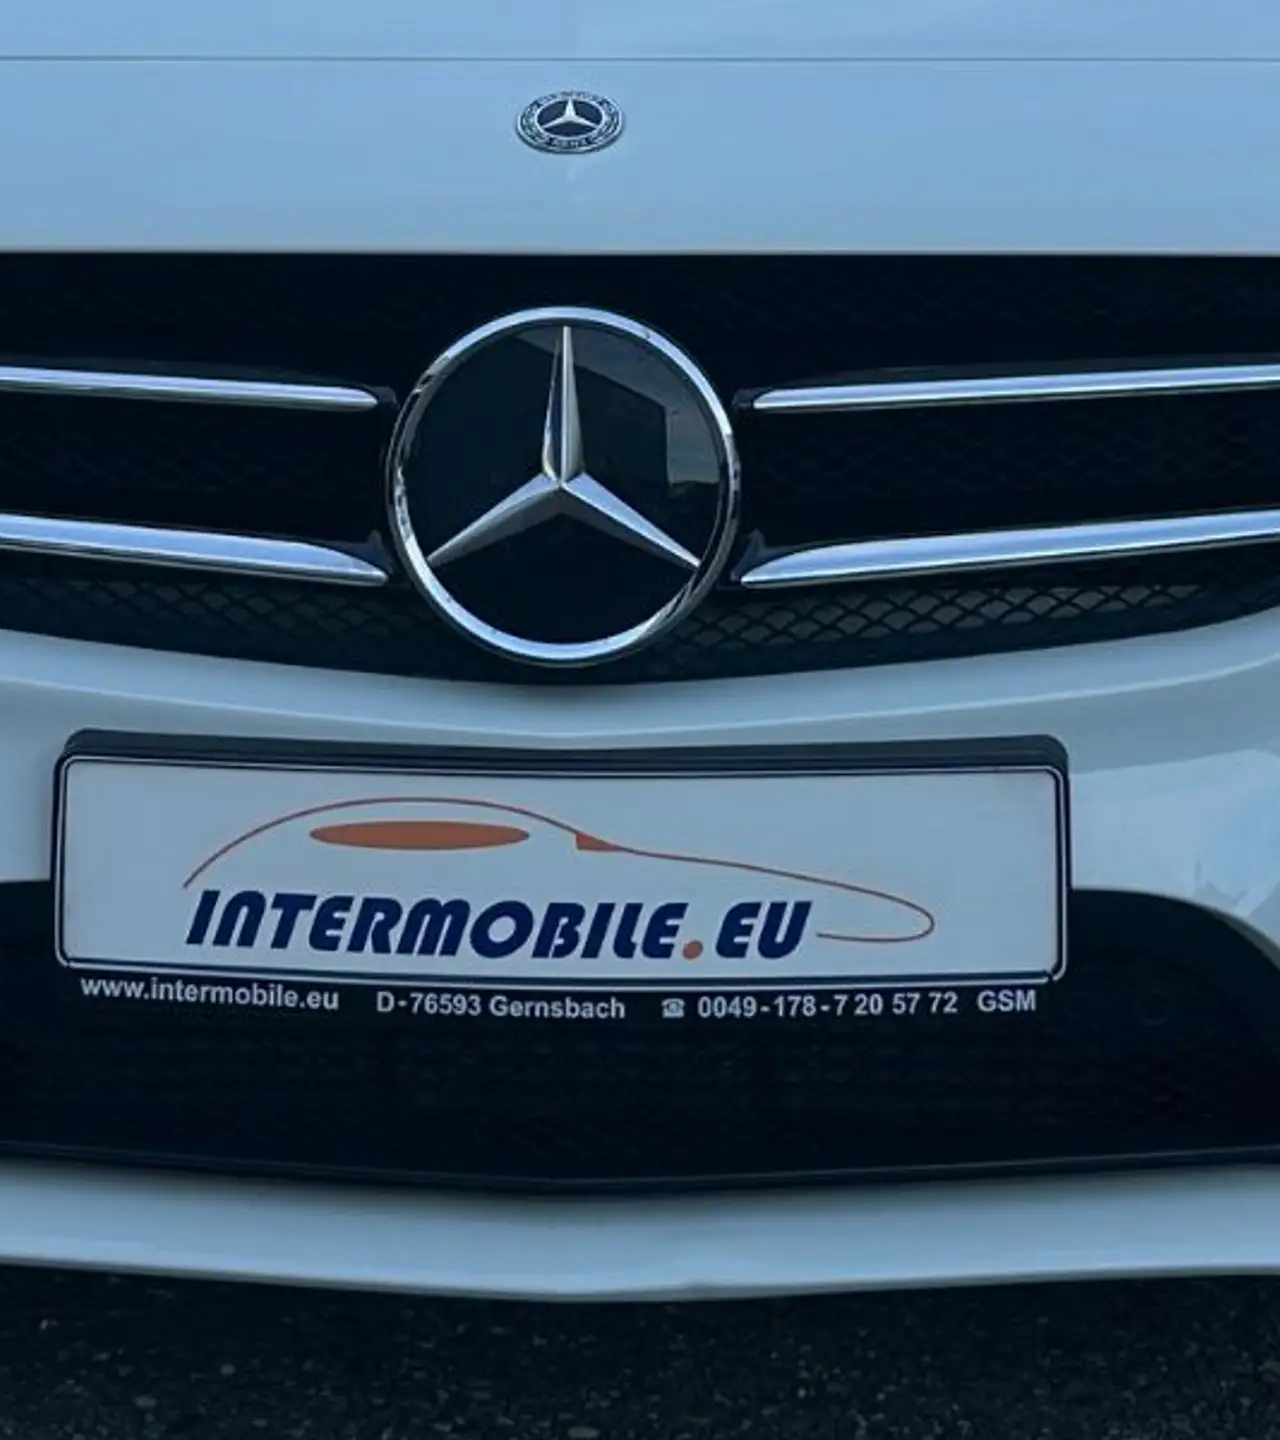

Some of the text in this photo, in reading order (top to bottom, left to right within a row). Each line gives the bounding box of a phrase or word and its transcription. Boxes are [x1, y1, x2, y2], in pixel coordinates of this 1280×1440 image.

[185, 890, 812, 960] INTERMOBILE.EU
[80, 977, 339, 1010] www.intermobile.eu
[489, 995, 625, 1019] Gernsbach
[976, 989, 1037, 1013] GSM
